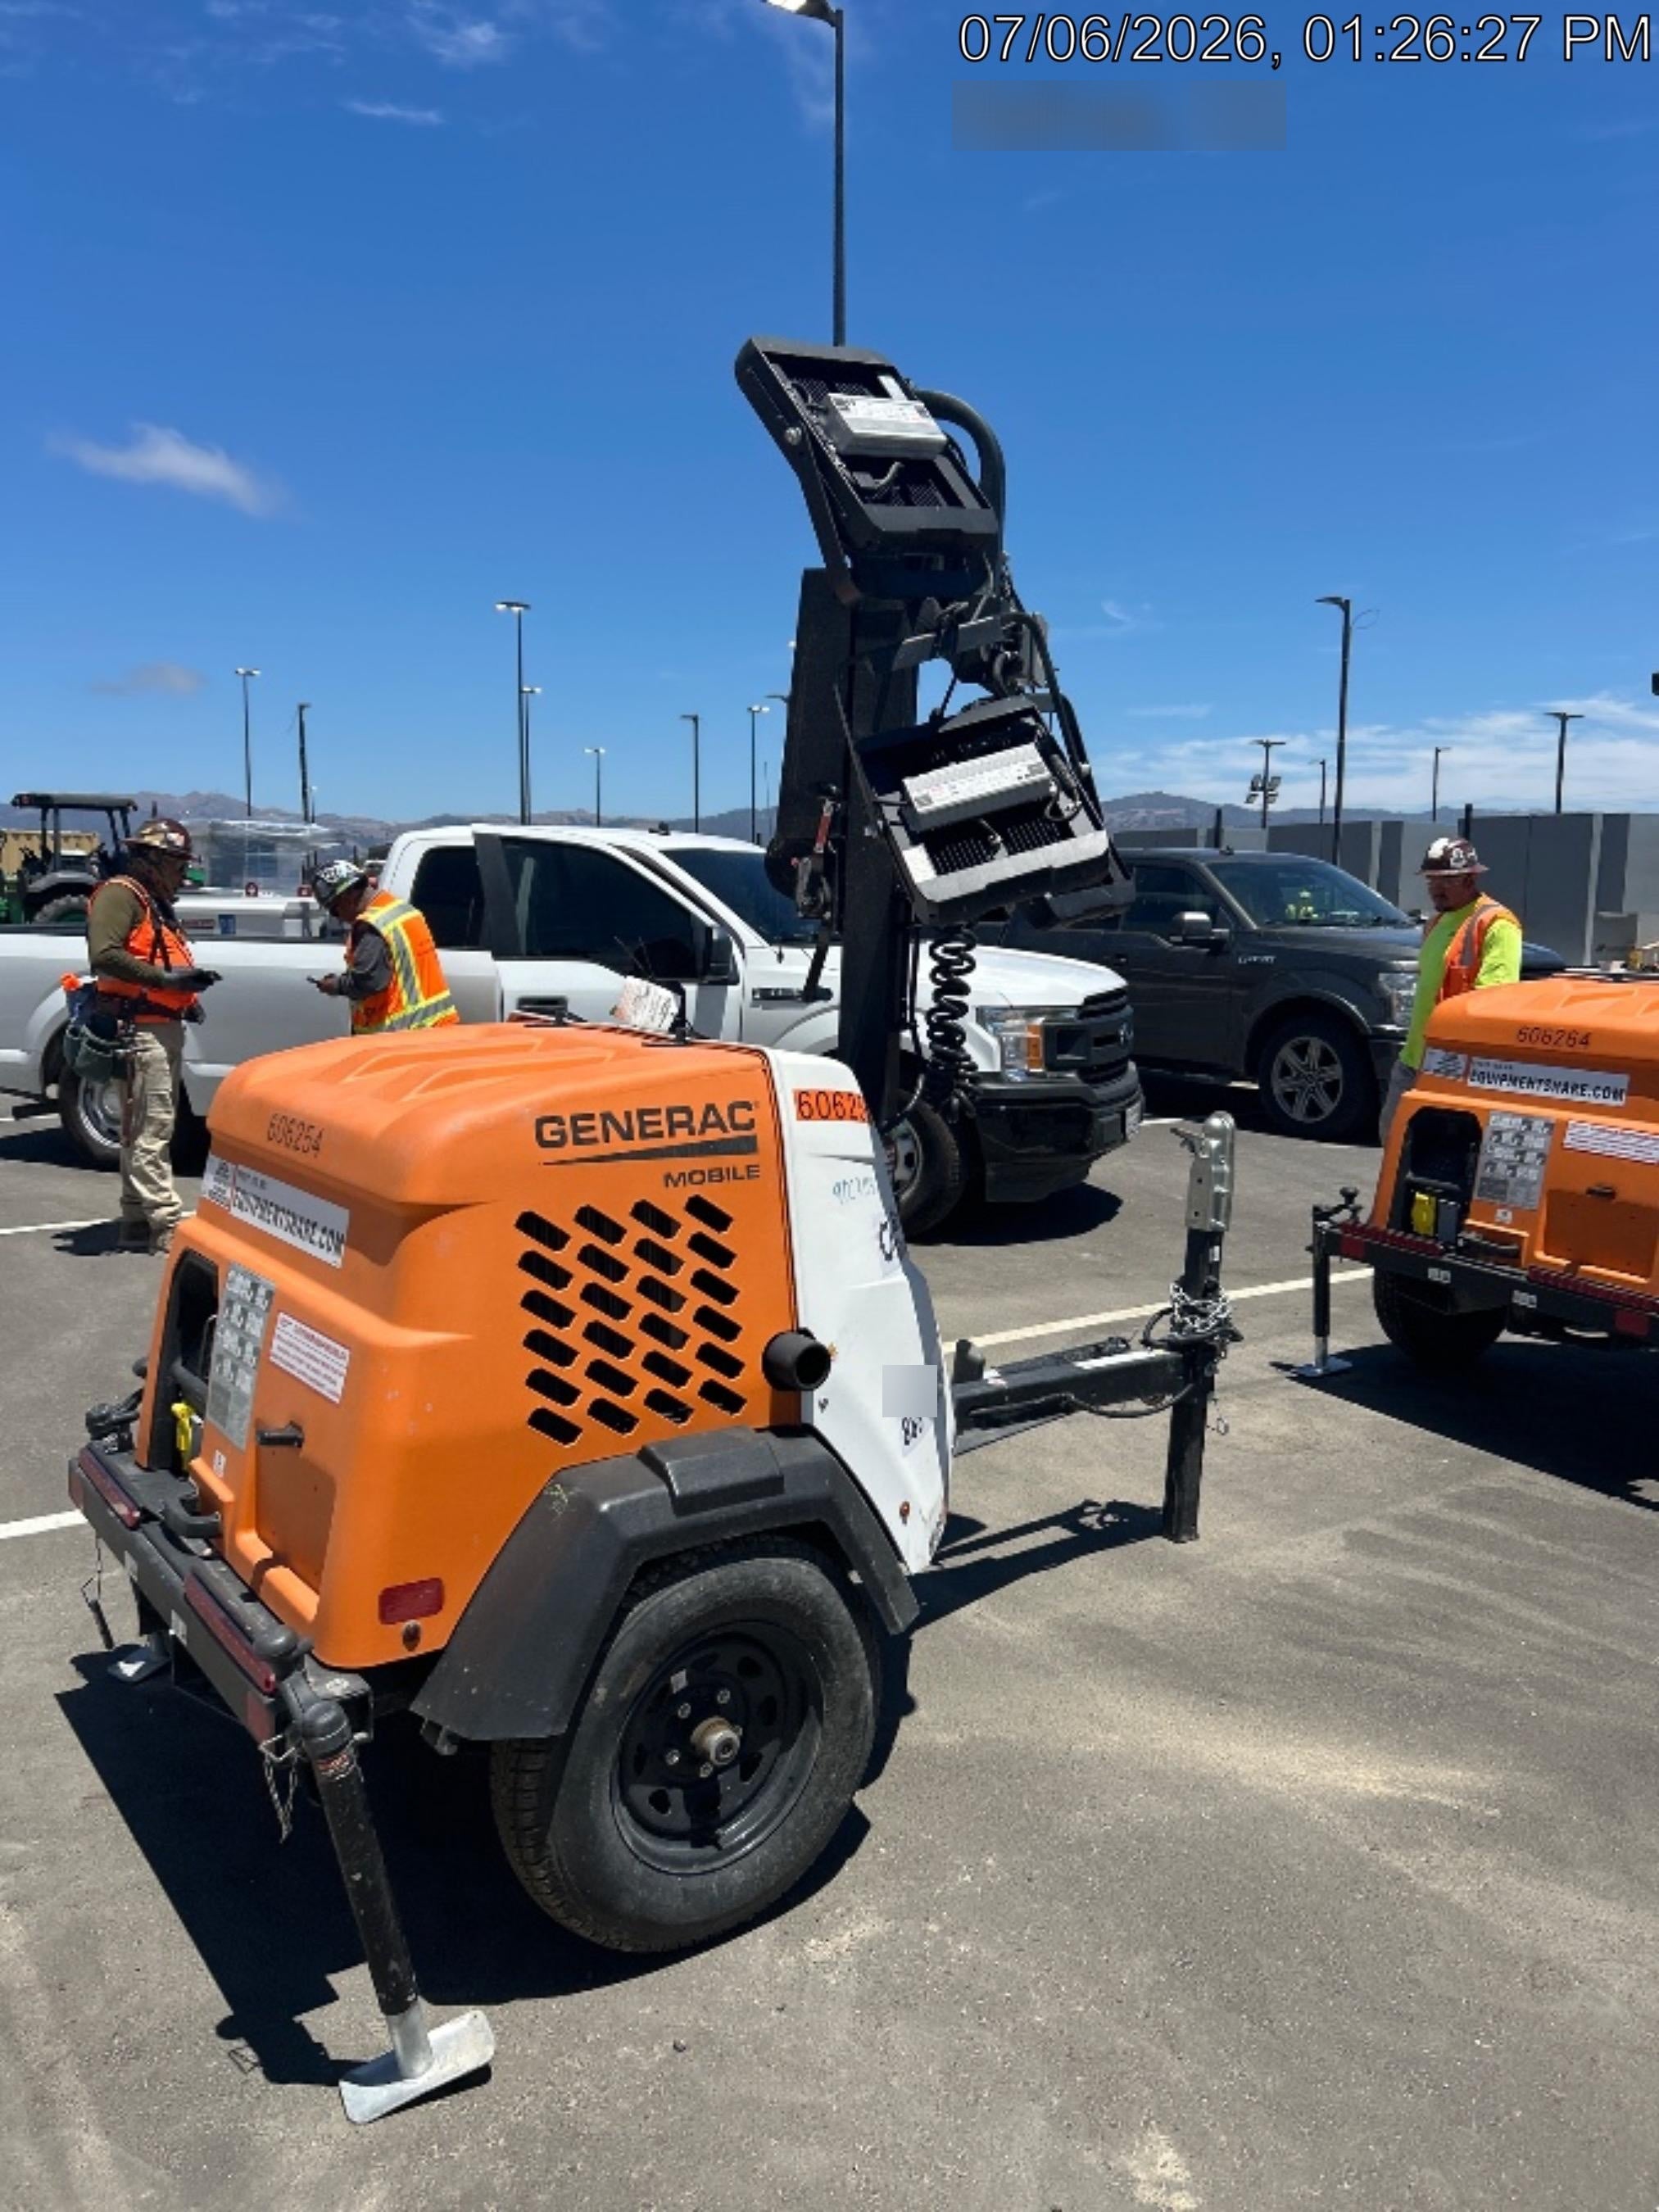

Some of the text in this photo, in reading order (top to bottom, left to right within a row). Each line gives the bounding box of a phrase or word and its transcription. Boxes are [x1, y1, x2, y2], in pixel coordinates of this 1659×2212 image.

[1517, 1027, 1592, 1049] 606264
[1469, 1067, 1625, 1102] EQUIPMENTSHARE.COM
[266, 1113, 325, 1158] 606254
[534, 1100, 755, 1149] GENERAC
[663, 1164, 760, 1188] MOBILE
